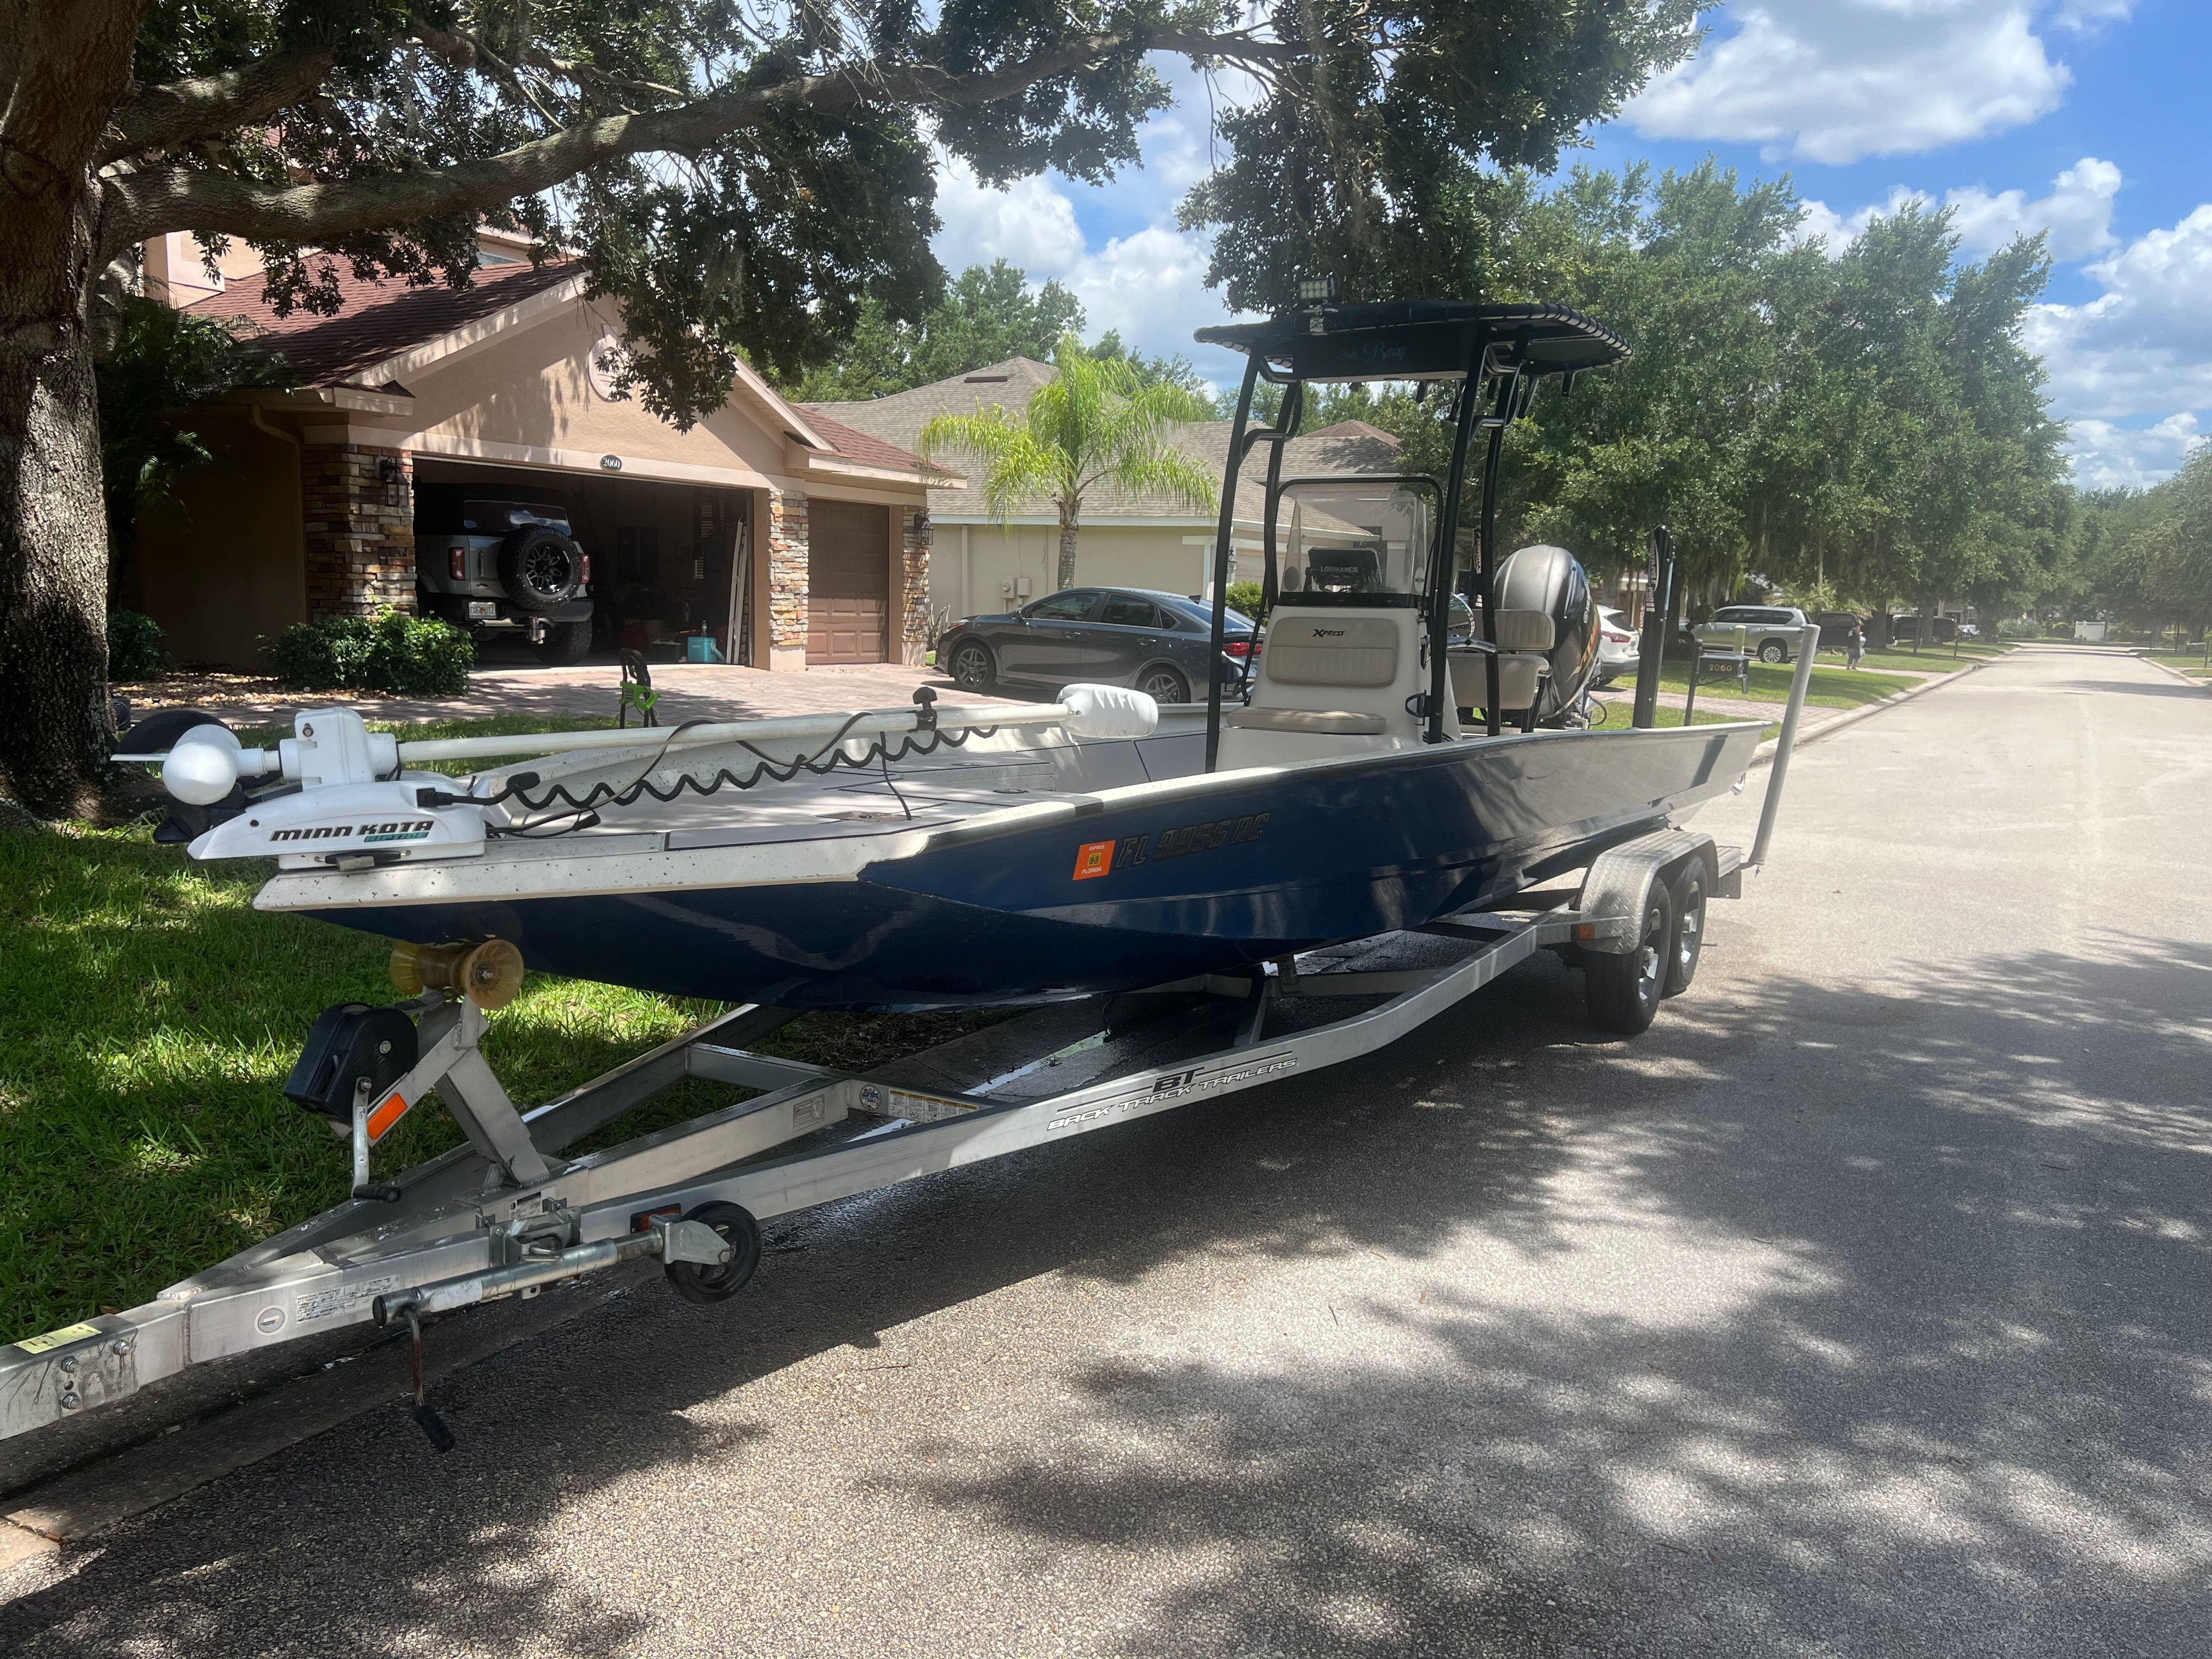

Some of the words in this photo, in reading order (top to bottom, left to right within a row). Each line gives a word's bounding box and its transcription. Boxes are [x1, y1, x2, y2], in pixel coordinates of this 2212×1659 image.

[602, 458, 620, 468] 2060
[1708, 664, 1732, 672] 2060
[269, 826, 353, 842] MINN
[357, 821, 435, 836] KOTA
[363, 831, 429, 842] RIPTIDE
[1114, 834, 1149, 870] FL
[1081, 866, 1102, 875] FLORIDA
[1152, 1066, 1205, 1093] BT
[1046, 1103, 1116, 1131] BACK
[1118, 1083, 1197, 1112] TRACK
[1198, 1057, 1298, 1091] TRAILERS
